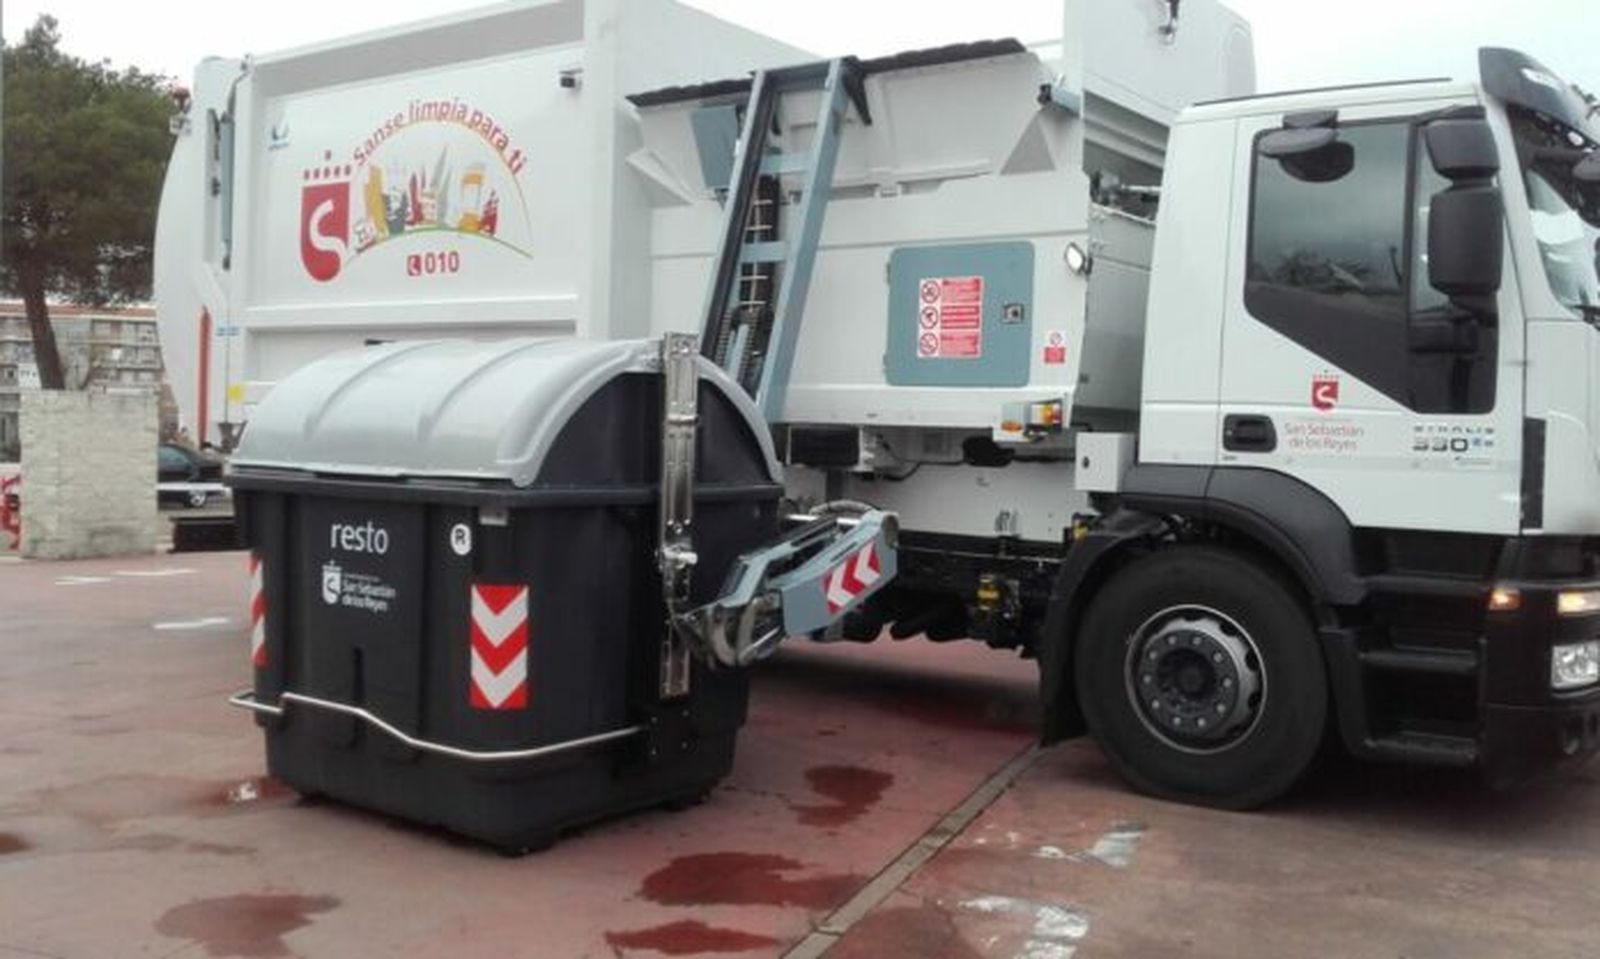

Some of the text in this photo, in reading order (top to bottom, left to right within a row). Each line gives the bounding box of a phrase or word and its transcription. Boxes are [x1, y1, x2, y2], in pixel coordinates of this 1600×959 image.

[408, 97, 468, 124] limpia
[468, 108, 509, 153] para
[507, 149, 528, 176] ti
[424, 251, 460, 274] 010
[1284, 422, 1305, 436] San
[330, 520, 389, 555] resto
